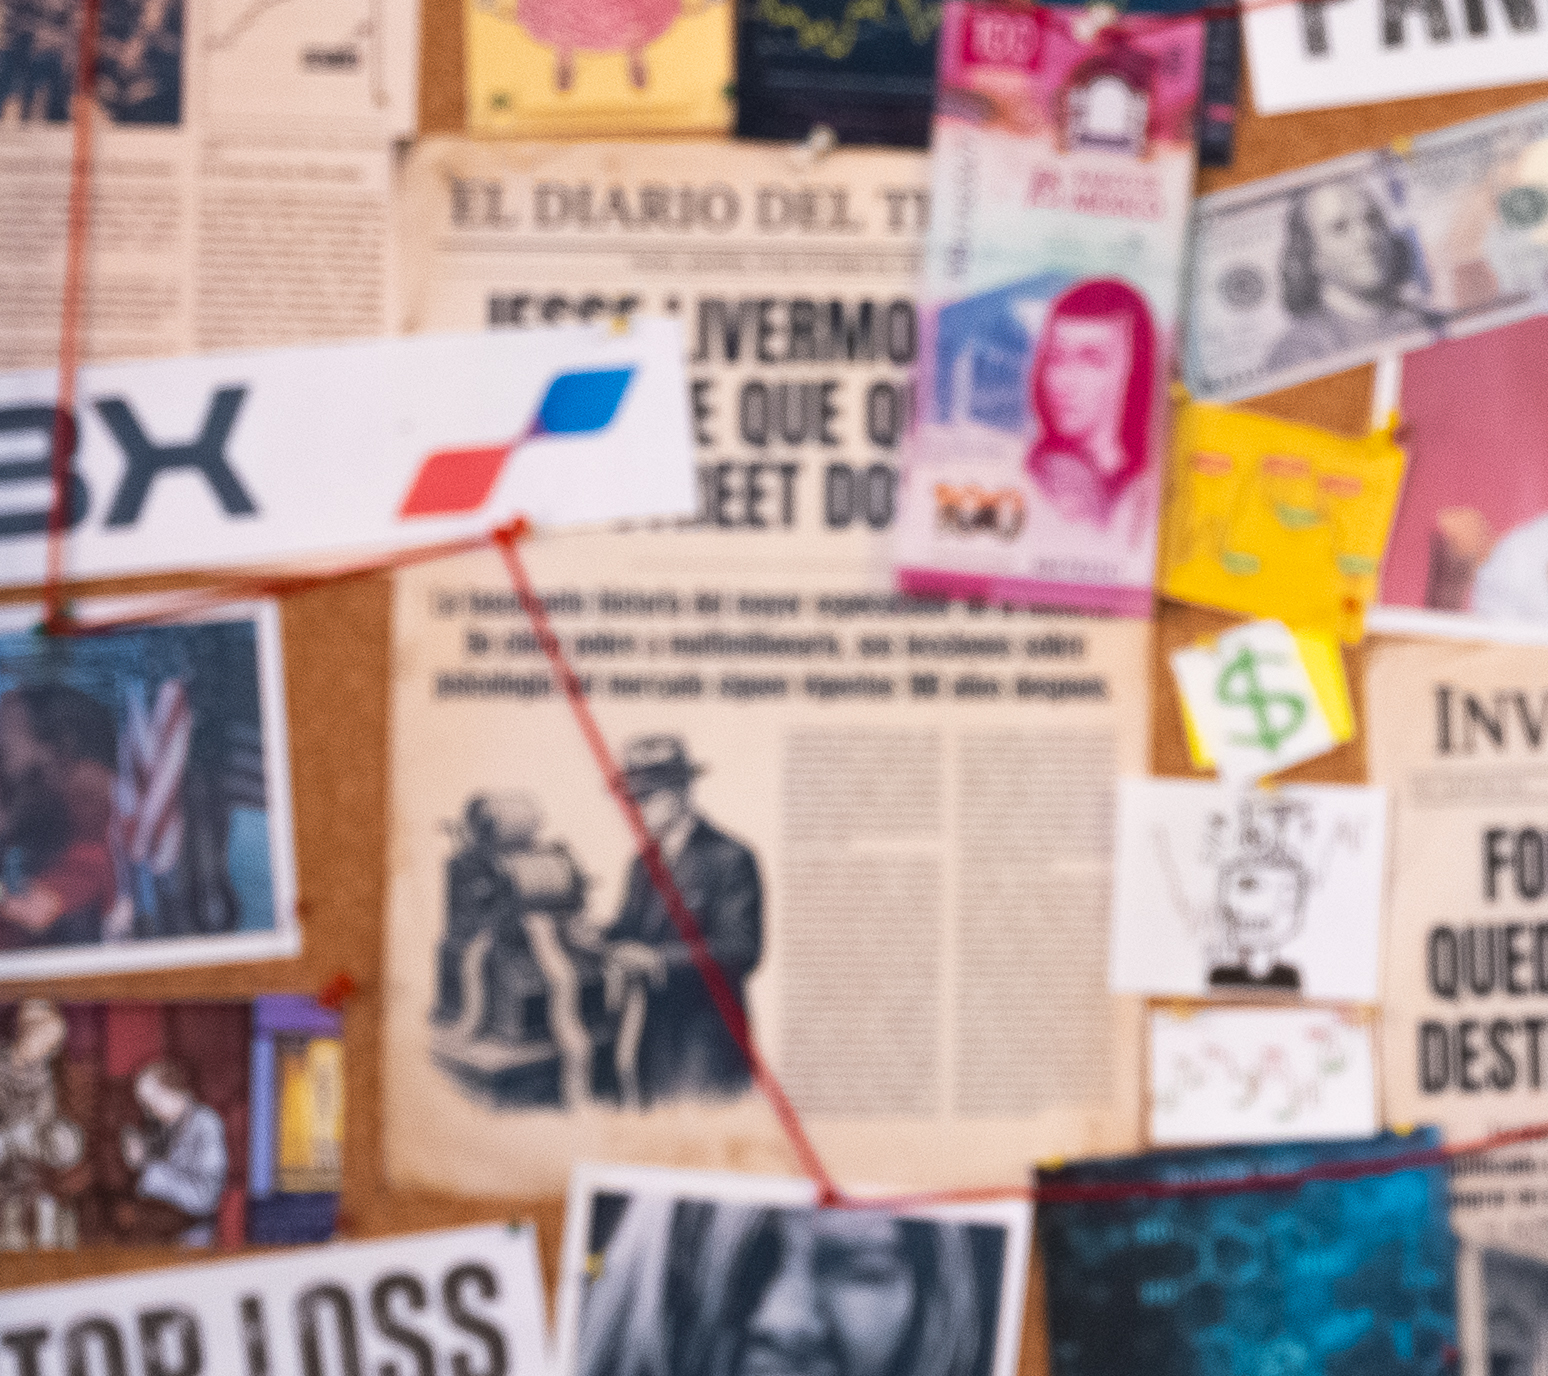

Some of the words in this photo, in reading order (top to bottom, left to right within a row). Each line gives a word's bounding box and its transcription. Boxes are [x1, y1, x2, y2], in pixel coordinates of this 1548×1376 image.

[450, 180, 519, 226] EL
[535, 181, 740, 230] DIARIO
[757, 183, 865, 233] DEL
[740, 380, 845, 450] QUE
